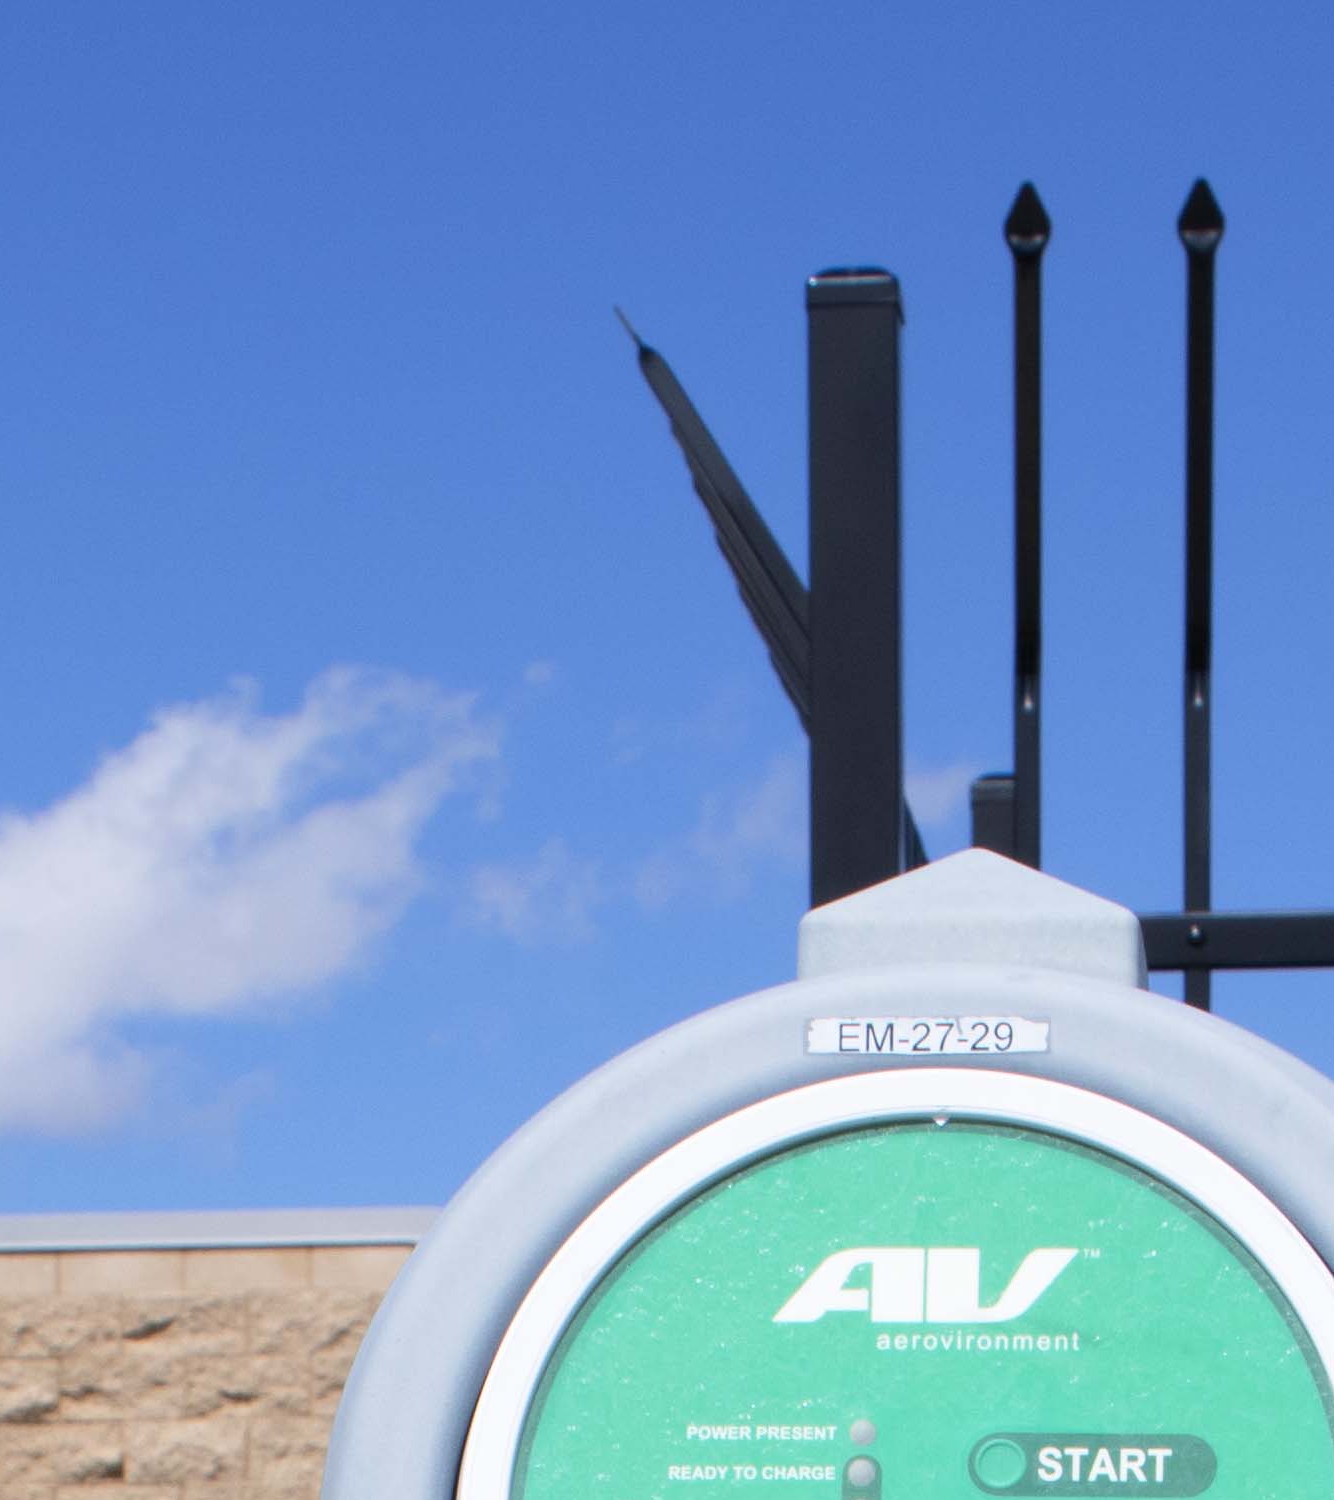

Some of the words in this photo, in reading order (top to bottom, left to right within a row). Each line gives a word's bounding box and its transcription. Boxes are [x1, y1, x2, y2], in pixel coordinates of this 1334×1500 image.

[839, 1022, 1014, 1052] EM-27-29
[875, 1331, 1080, 1351] aerovironment
[686, 1425, 751, 1440] POWER
[756, 1425, 838, 1440] PRESENT
[668, 1465, 728, 1480] READY
[733, 1465, 755, 1480] TO
[762, 1465, 836, 1480] CHARGE
[1037, 1447, 1172, 1482] START
